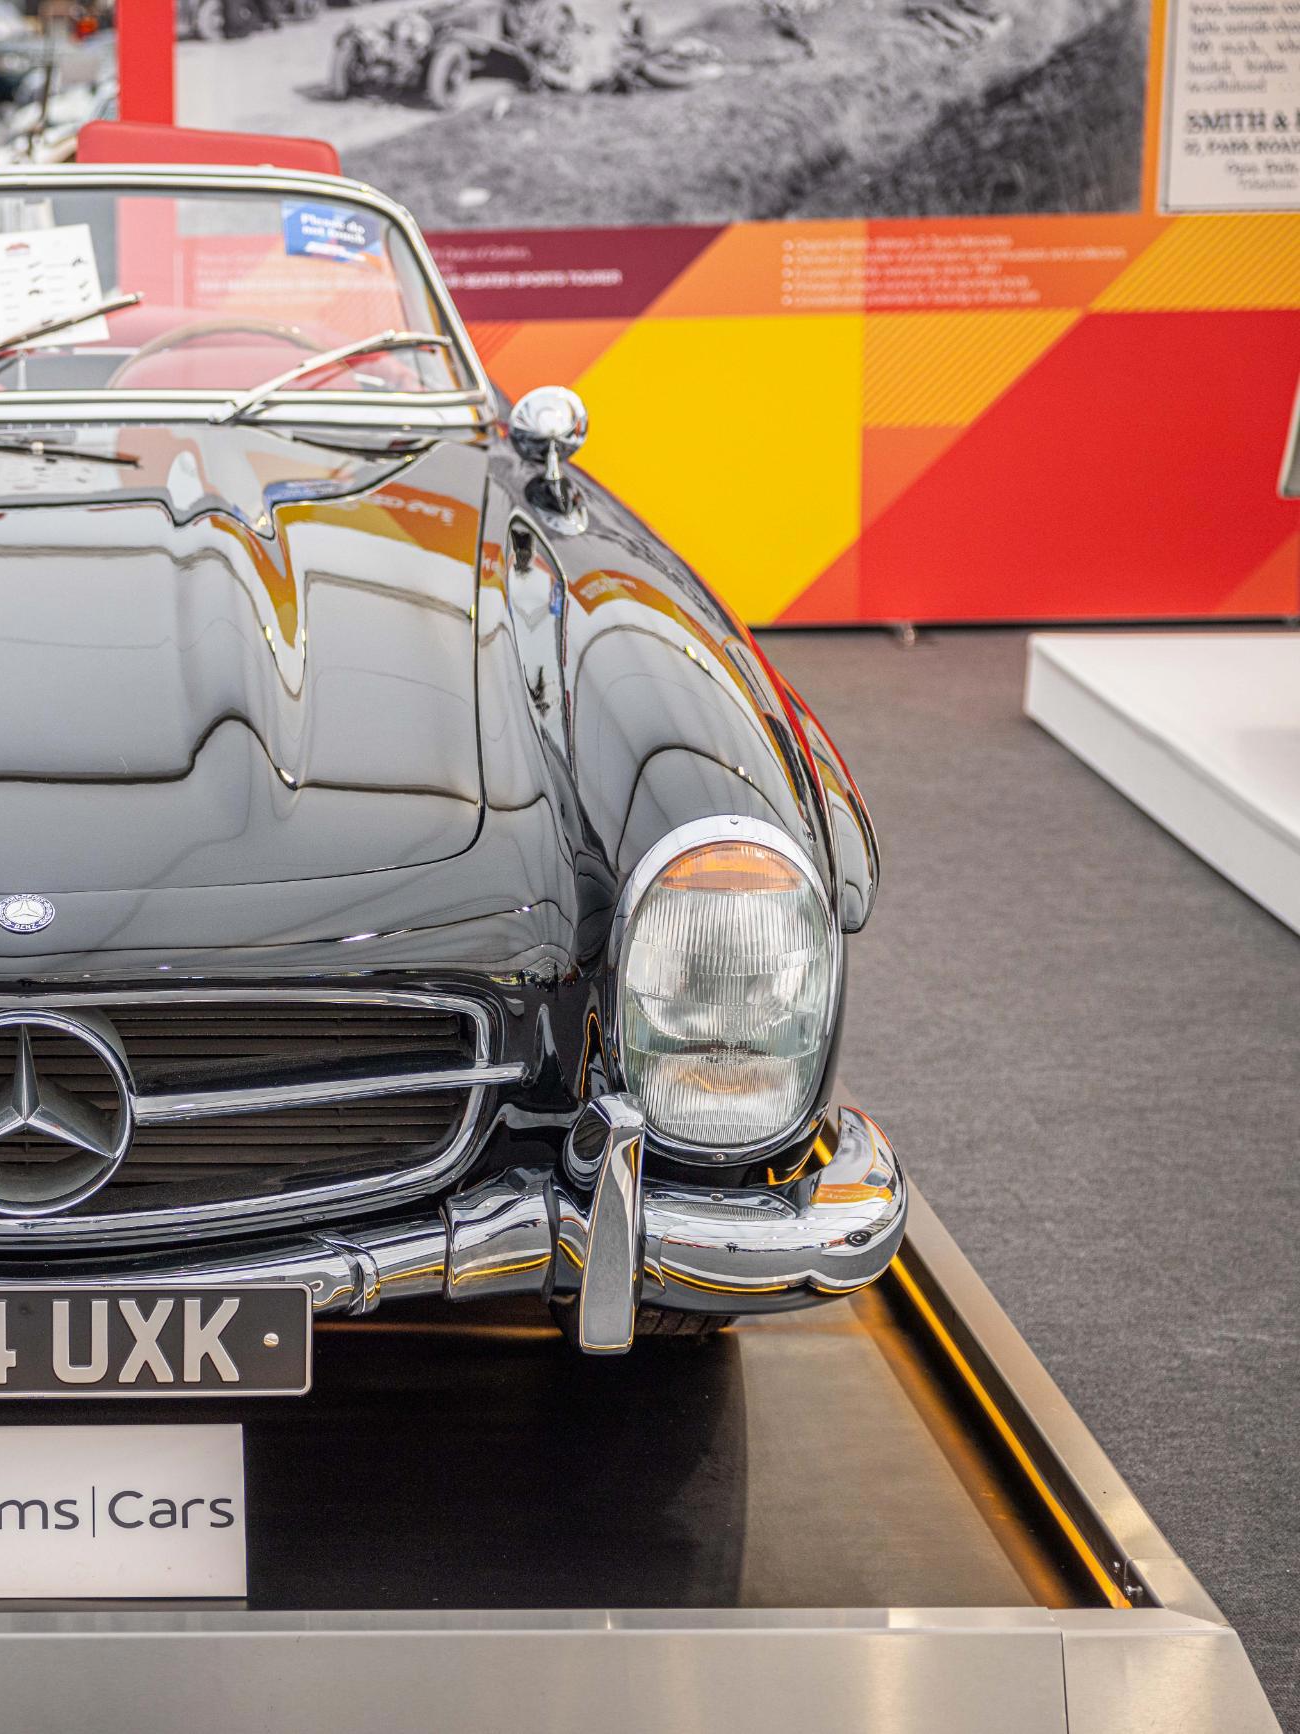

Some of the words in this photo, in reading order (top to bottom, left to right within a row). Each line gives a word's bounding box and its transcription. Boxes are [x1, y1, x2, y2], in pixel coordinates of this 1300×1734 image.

[1188, 110, 1266, 134] SMITH
[1274, 112, 1288, 132] &
[300, 212, 346, 230] Please
[346, 220, 366, 235] do
[51, 1298, 241, 1384] UXK
[108, 1490, 235, 1530] Cars
